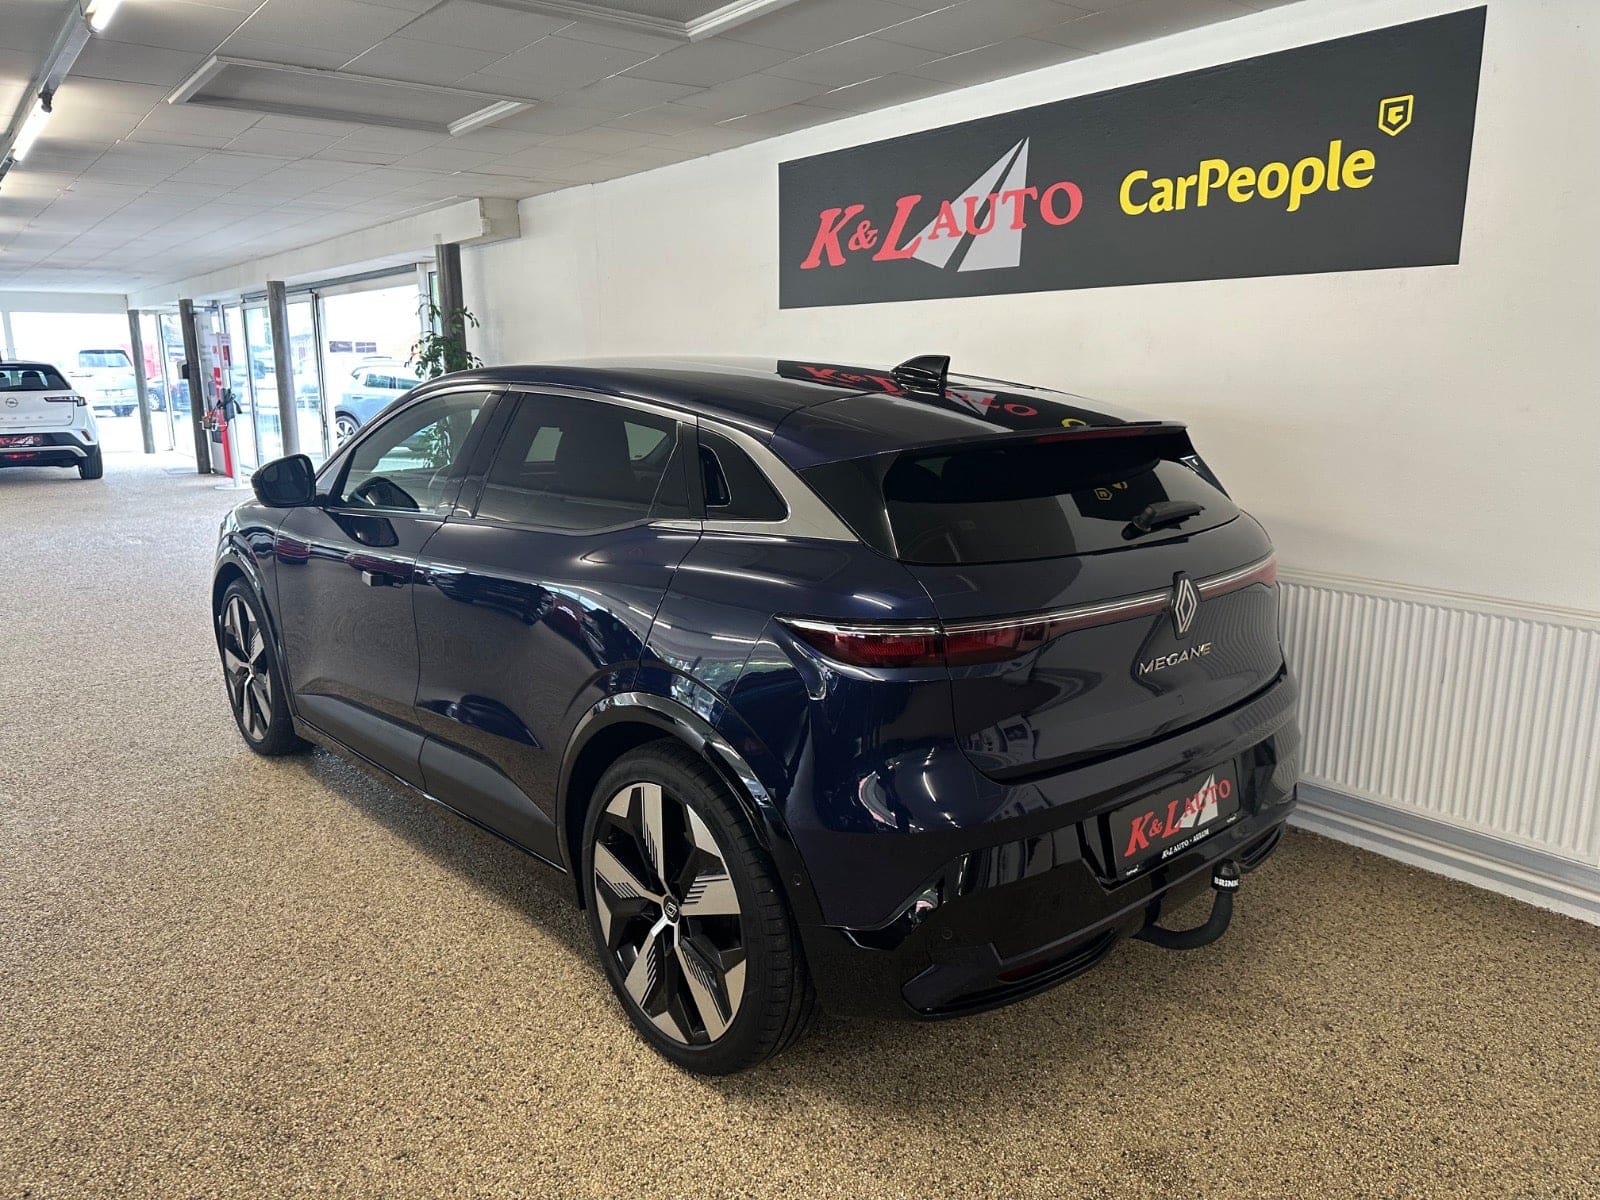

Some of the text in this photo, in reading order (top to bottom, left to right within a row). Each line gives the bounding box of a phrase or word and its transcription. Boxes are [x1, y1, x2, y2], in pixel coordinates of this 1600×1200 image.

[1119, 139, 1376, 215] CarPeople
[800, 181, 1083, 269] K&L AUTO
[1138, 642, 1212, 676] MEGANE
[1124, 779, 1231, 857] K&L AUTO
